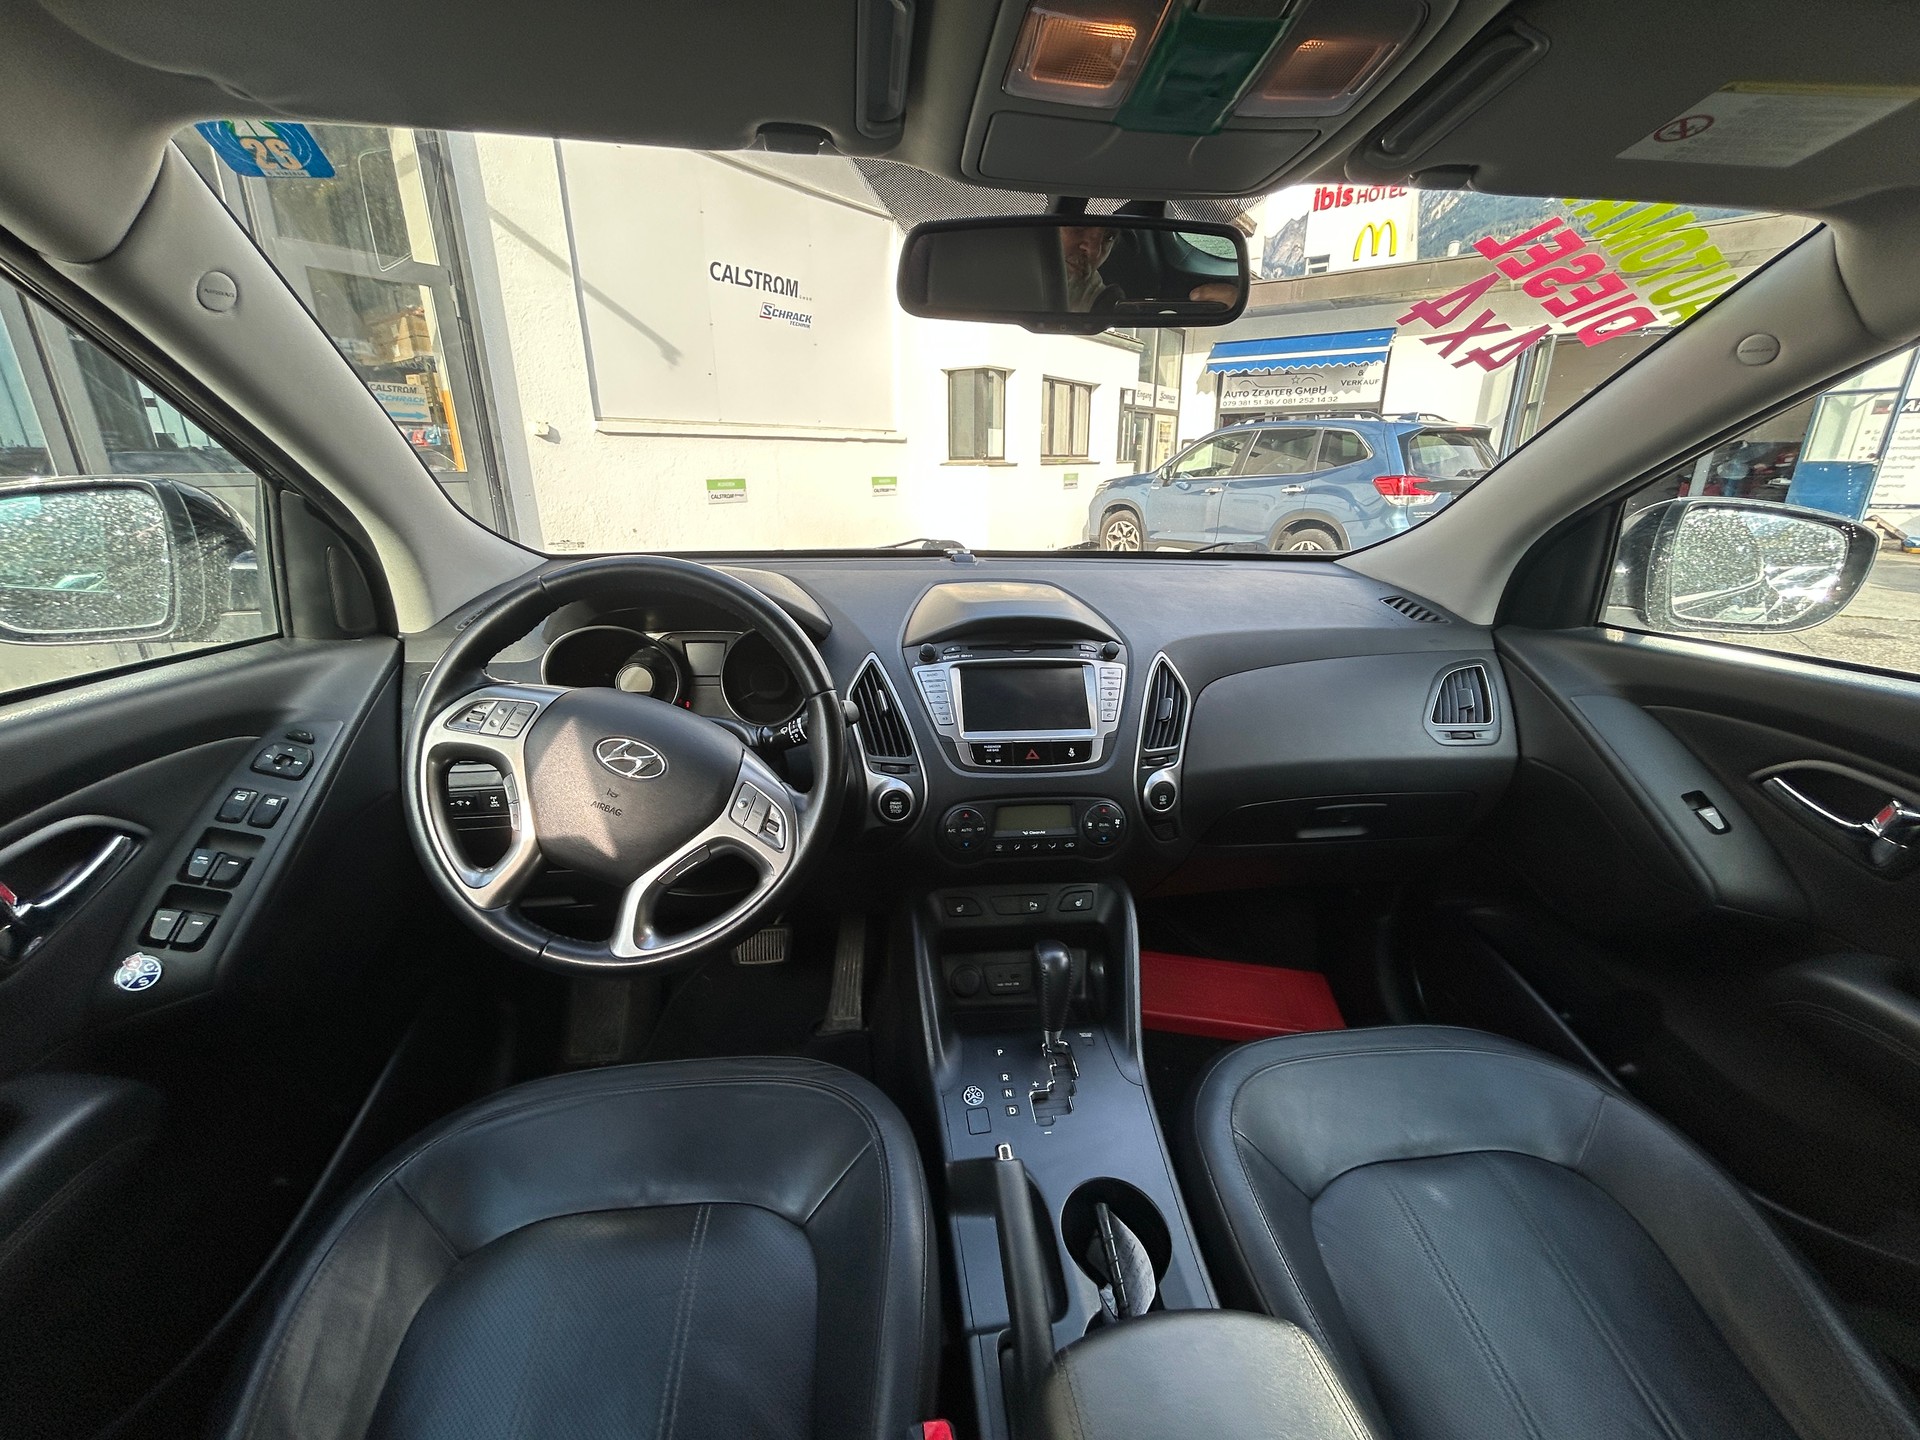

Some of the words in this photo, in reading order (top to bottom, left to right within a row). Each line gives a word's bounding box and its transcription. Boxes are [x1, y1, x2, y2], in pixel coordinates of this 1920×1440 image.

[1313, 185, 1354, 212] ibis
[1356, 185, 1408, 205] HOTEL
[1340, 378, 1380, 387] VERKAUF
[590, 800, 623, 817] AIRBAG
[1002, 1073, 1009, 1081] R
[1005, 1089, 1013, 1097] N
[1008, 1107, 1017, 1115] D
